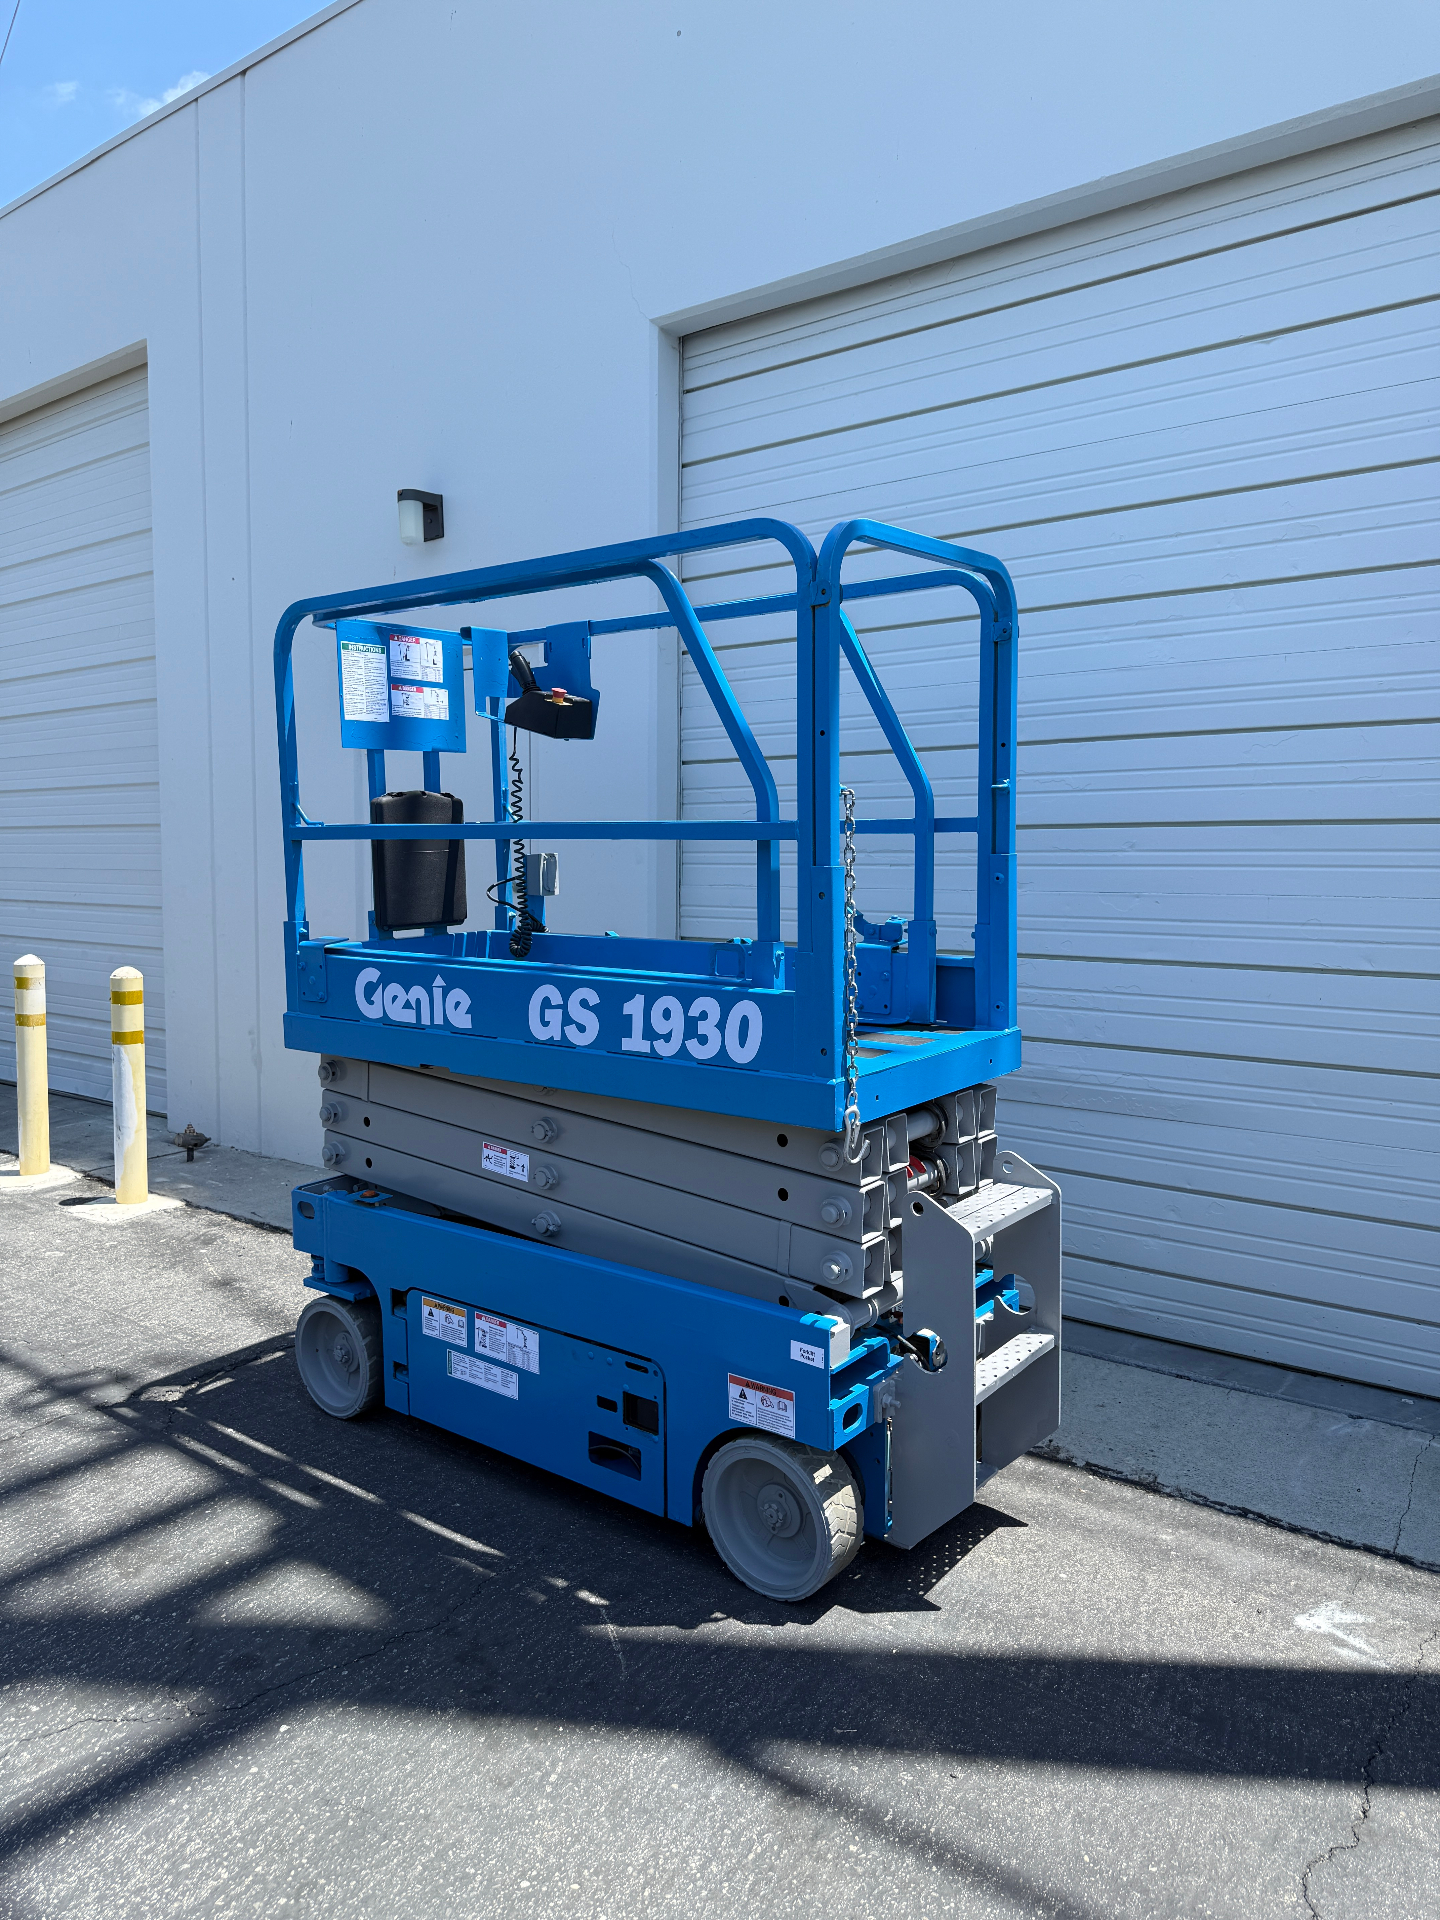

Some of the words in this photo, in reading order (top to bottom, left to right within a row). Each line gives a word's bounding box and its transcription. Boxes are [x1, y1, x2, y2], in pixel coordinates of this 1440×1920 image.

[398, 635, 416, 643] DANGER
[348, 643, 382, 654] INSTRUCTIONS
[354, 967, 473, 1029] Genie
[528, 984, 601, 1046] GS
[621, 993, 763, 1064] 1930
[485, 1316, 500, 1326] DANGER
[799, 1347, 816, 1358] Forklift
[799, 1353, 815, 1363] Pocket
[751, 1382, 777, 1396] WARNING
